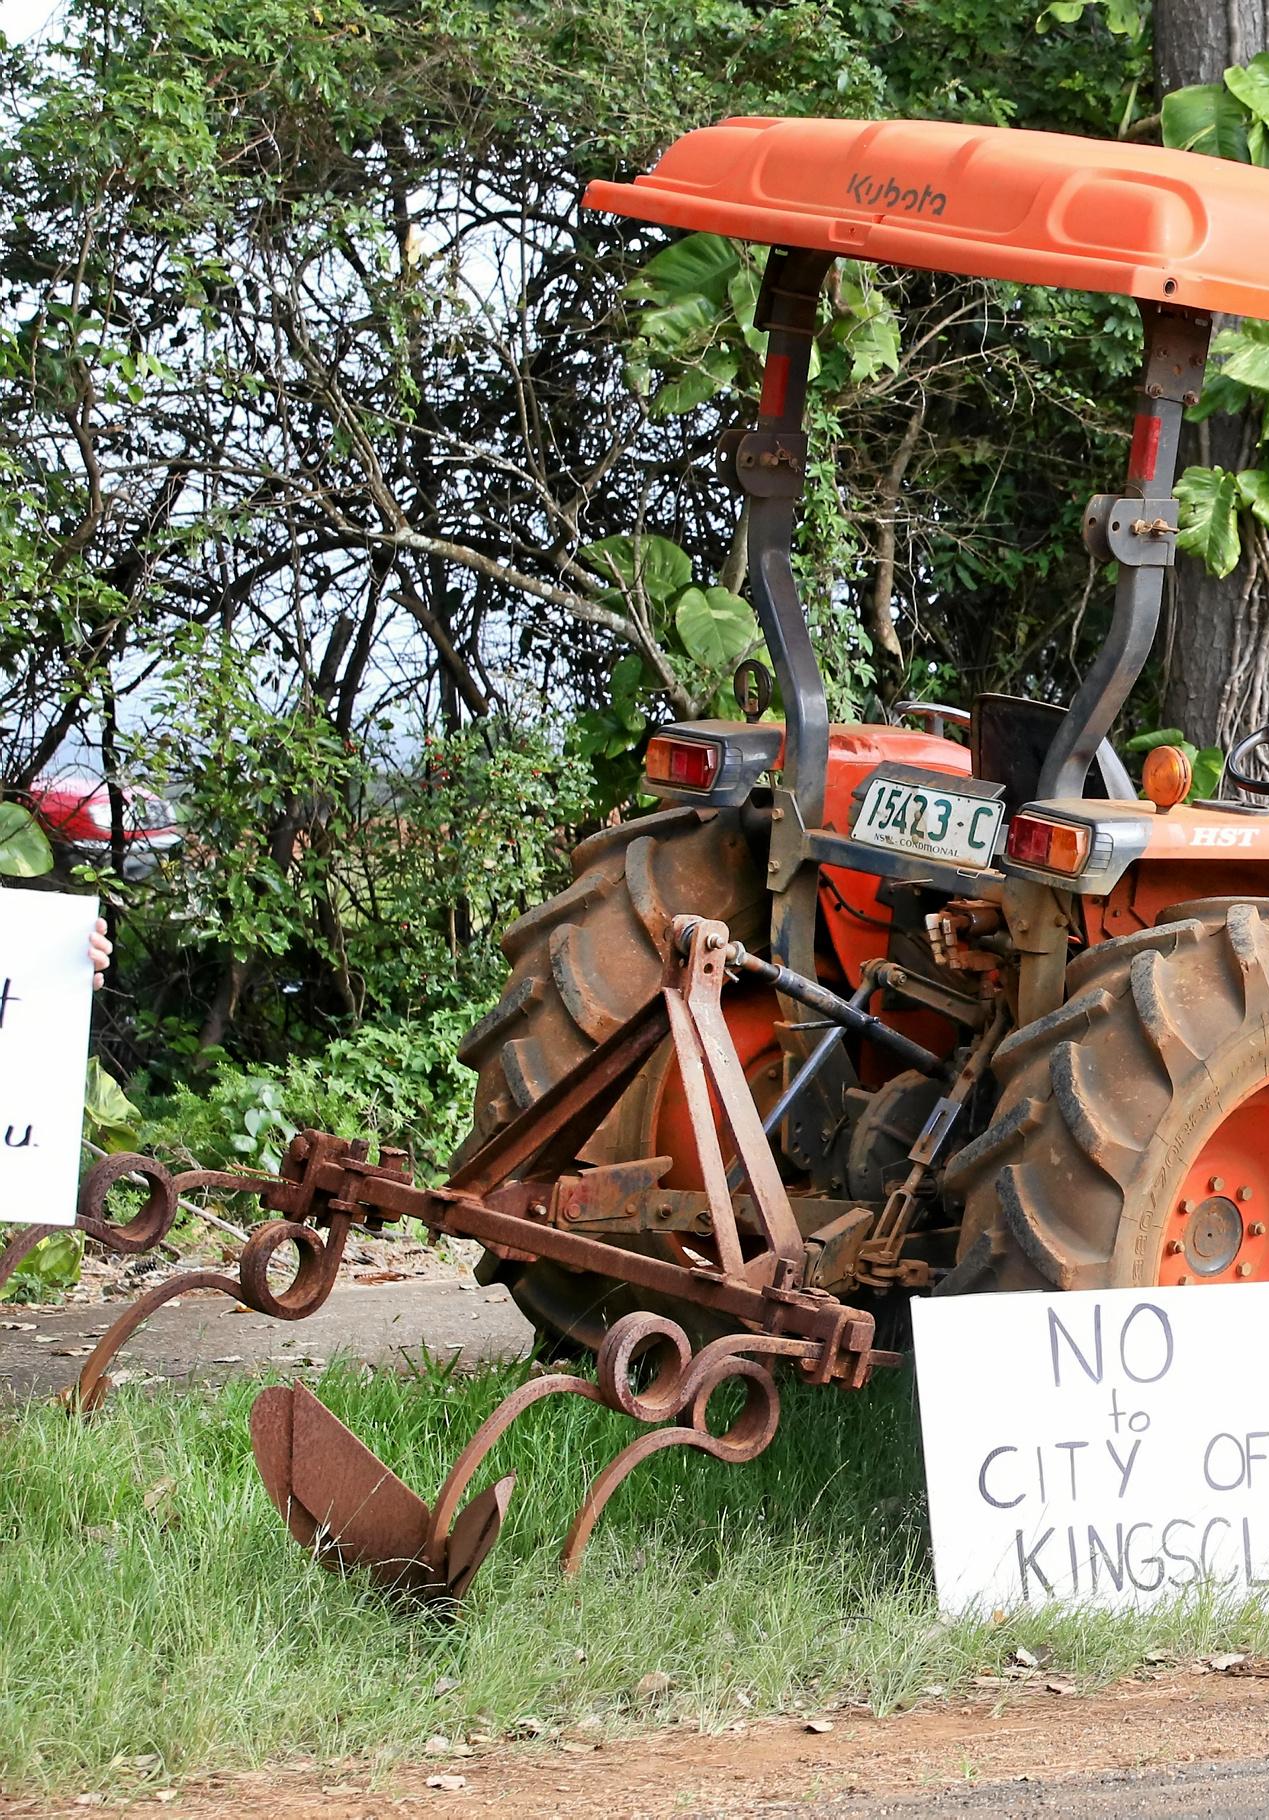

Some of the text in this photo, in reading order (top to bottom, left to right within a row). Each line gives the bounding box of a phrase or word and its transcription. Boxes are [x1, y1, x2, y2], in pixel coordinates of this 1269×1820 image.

[847, 173, 947, 216] Kubota
[899, 838, 959, 858] CONDITIONAL
[1189, 827, 1261, 847] HST
[1048, 1302, 1174, 1387] NO
[1108, 1388, 1151, 1433] to
[979, 1439, 1142, 1509] CITY
